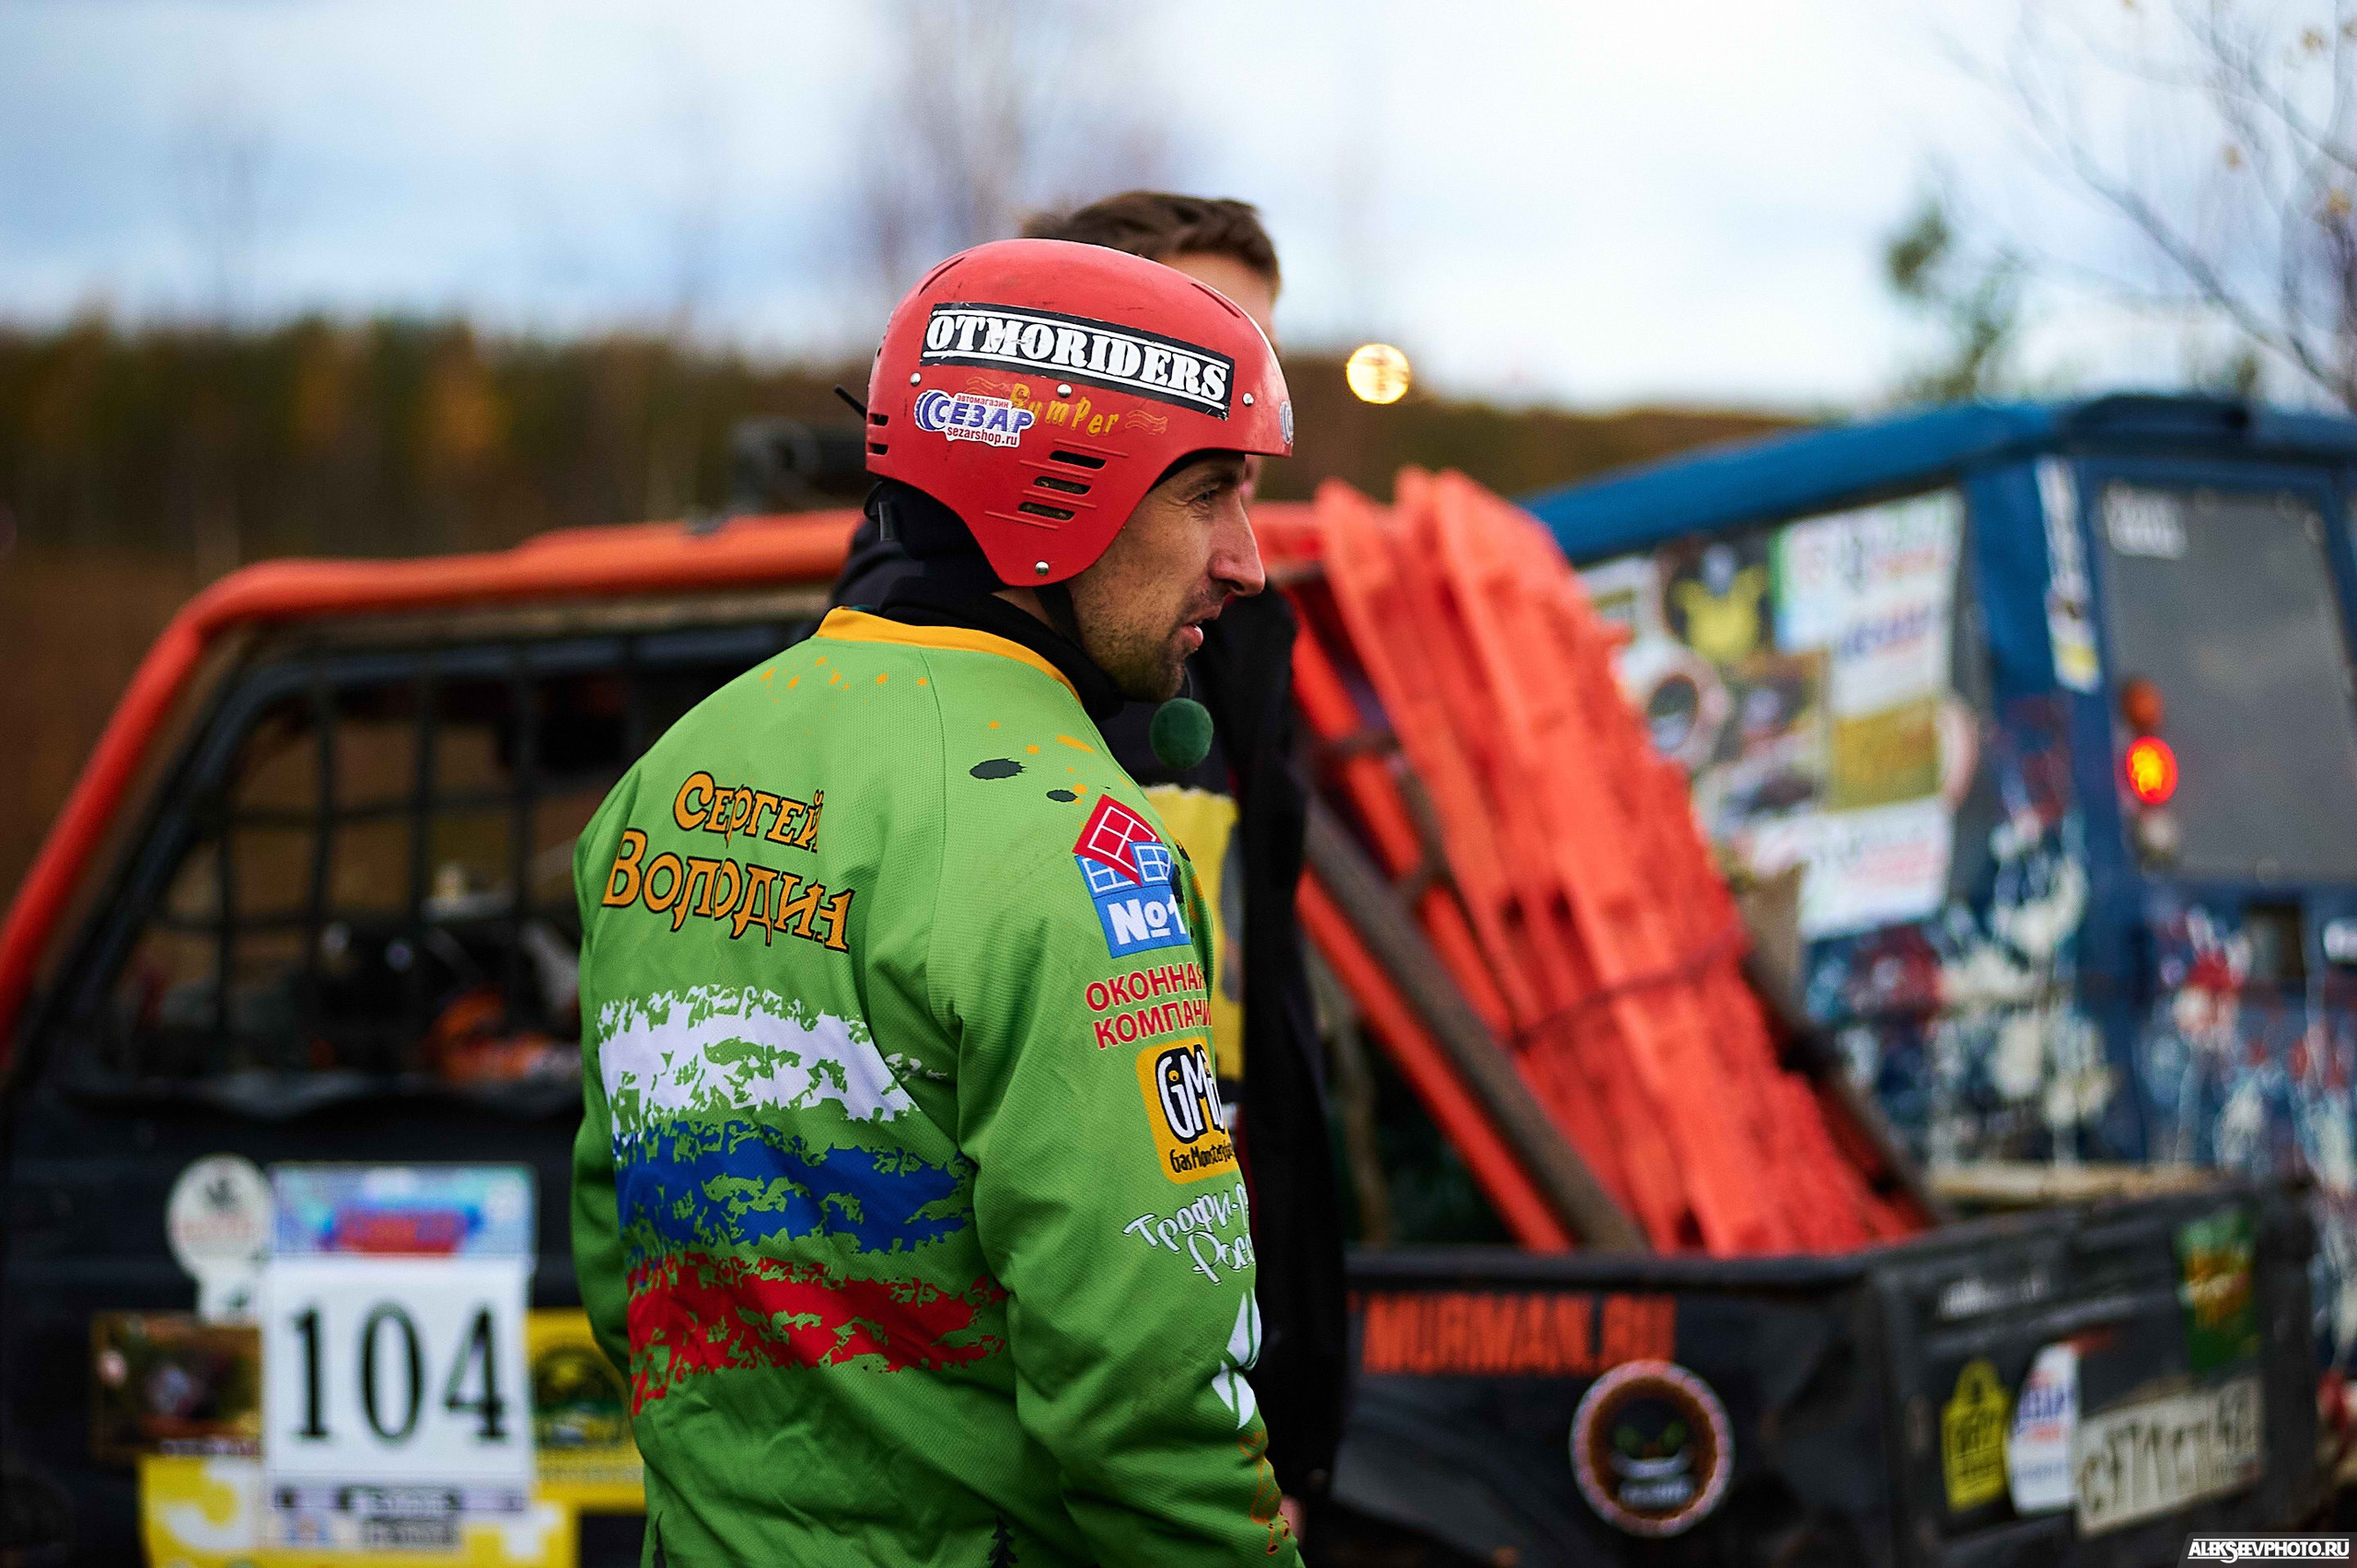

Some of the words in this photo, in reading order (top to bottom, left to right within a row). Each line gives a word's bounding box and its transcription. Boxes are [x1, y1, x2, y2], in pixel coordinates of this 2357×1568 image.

[926, 316, 1226, 401] OTMORIDERS
[934, 400, 1033, 433] СЕЗАР
[957, 395, 1009, 408] автомагазин
[946, 426, 1018, 446] sezarshop.ru
[293, 1300, 508, 1443] 104
